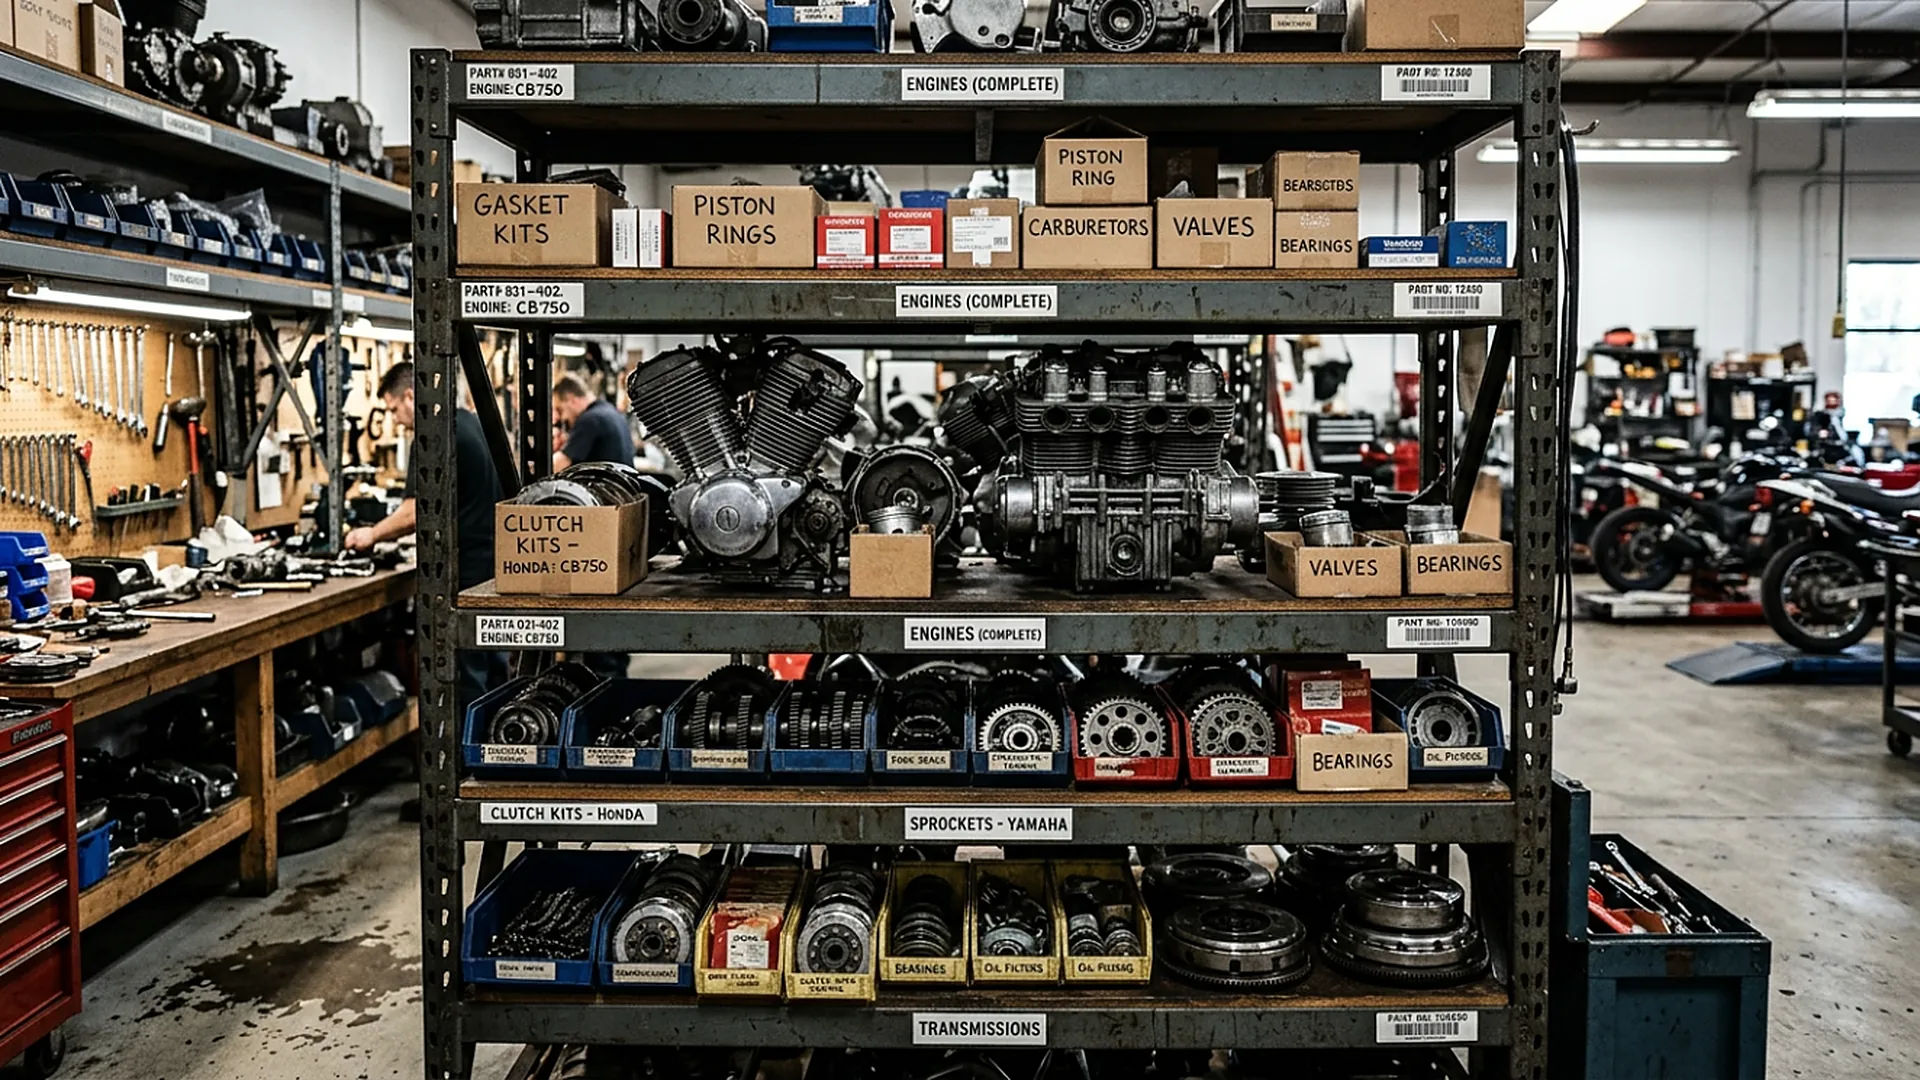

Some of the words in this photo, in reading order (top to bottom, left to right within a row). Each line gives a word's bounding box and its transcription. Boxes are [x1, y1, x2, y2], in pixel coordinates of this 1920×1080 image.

[470, 83, 514, 94] ENGINE:
[515, 83, 563, 96] CB750
[907, 77, 968, 92] ENGINES
[973, 77, 1059, 95] (COMPLETE)
[1059, 148, 1123, 165] PISTON
[1072, 169, 1115, 186] RING
[473, 193, 570, 217] GASKET
[694, 195, 775, 217] PISTON
[494, 222, 550, 244] KITS
[707, 223, 777, 245] RINGS
[1028, 218, 1149, 237] CARBURETORS
[1173, 216, 1255, 238] VALVES
[1280, 238, 1353, 254] BEARINGS
[517, 301, 570, 315] CB750
[901, 294, 962, 308] ENGINES
[966, 294, 1053, 311] (COMPLETE)
[503, 514, 584, 533] CLUTCH
[517, 536, 561, 554] KITS
[560, 559, 608, 573] CB750
[1309, 559, 1379, 576] VALVES
[1417, 554, 1502, 574] BEARINGS
[911, 626, 974, 641] ENGINES
[979, 629, 1042, 642] (COMPLETE)
[1313, 752, 1393, 772] BEARINGS
[491, 806, 545, 820] CLUTCH
[551, 806, 583, 820] KITS
[598, 806, 645, 820] HONDA
[910, 816, 993, 831] SPROCKETS
[1008, 817, 1068, 831] YAMAHA
[919, 1021, 1041, 1036] TRANSMISSIONS
